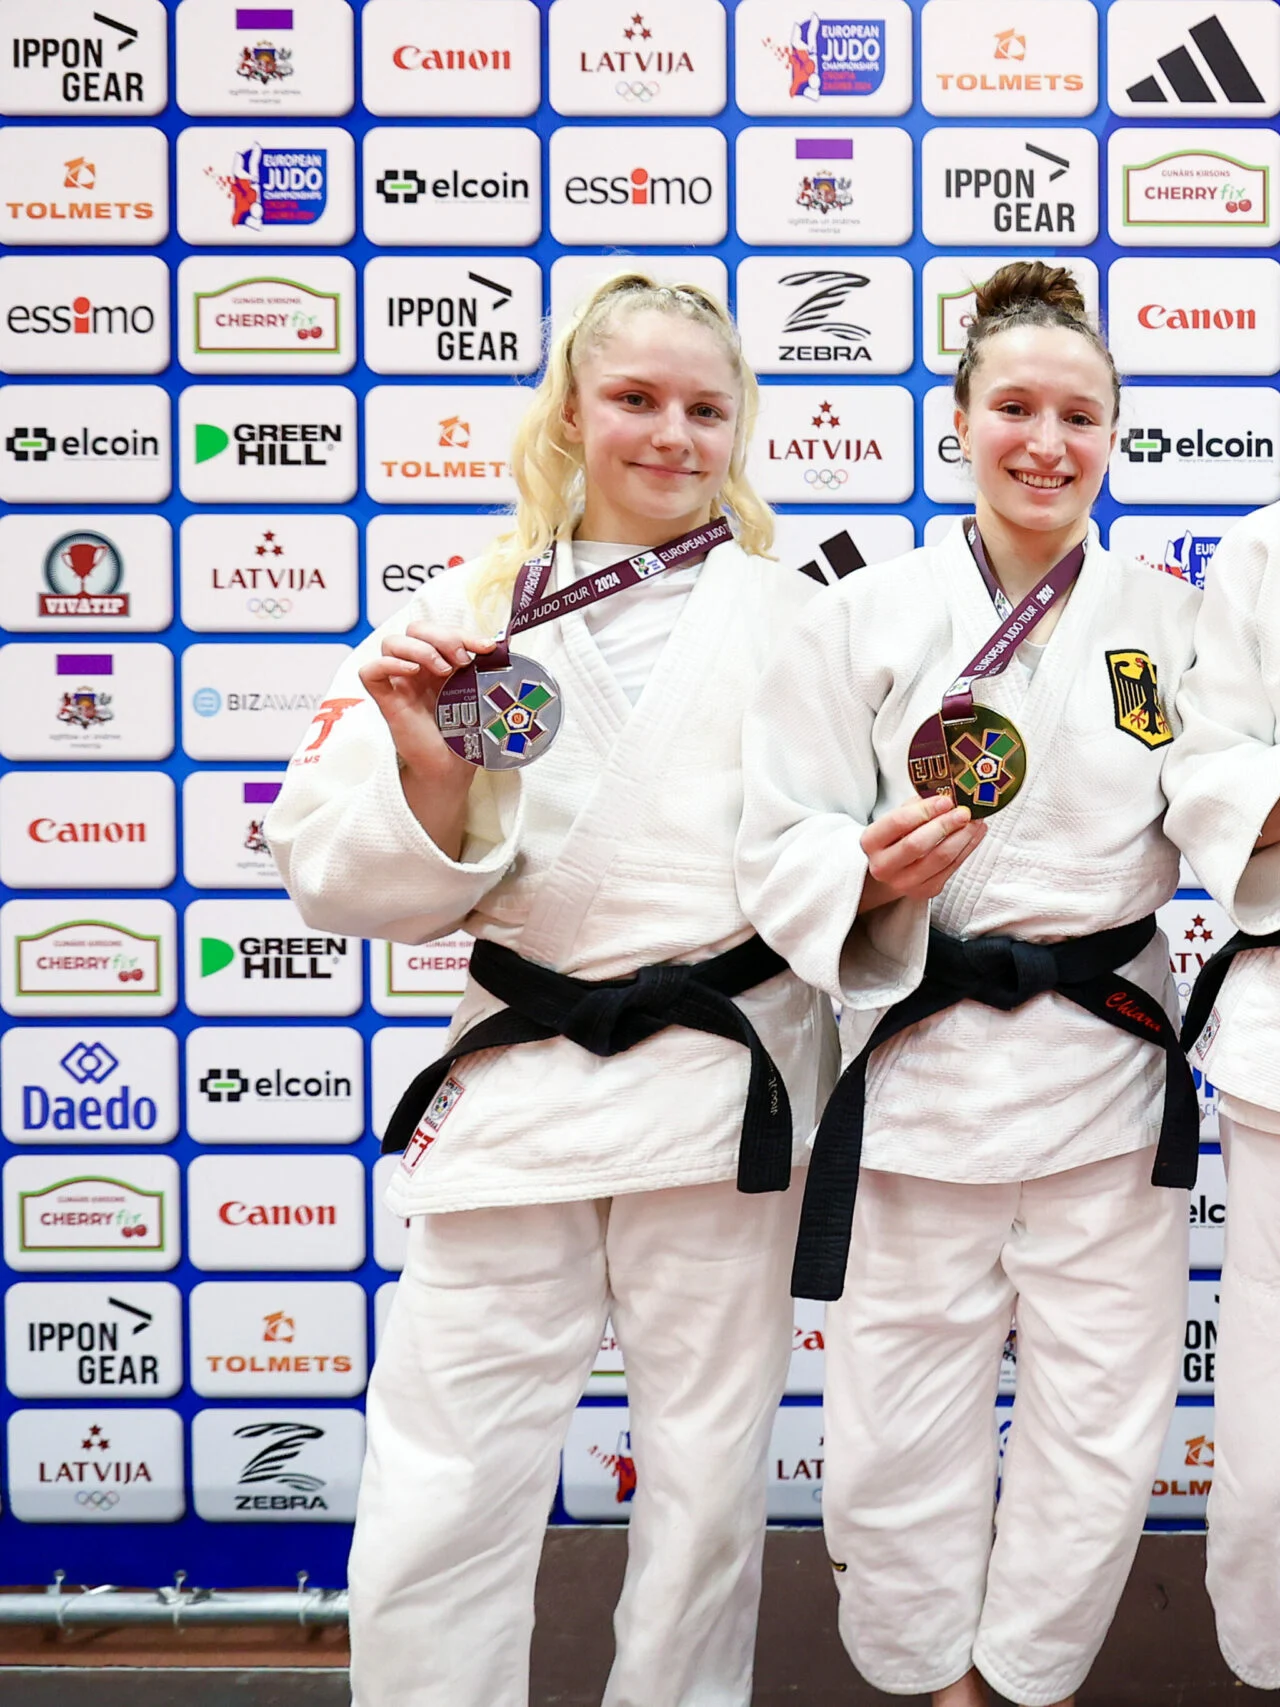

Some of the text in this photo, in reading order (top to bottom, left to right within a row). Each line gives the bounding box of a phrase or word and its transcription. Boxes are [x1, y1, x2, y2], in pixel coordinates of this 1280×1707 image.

[821, 24, 880, 39] EUROPEAN
[13, 38, 102, 68] IPPON
[393, 46, 510, 70] Canon
[821, 38, 881, 62] JUDO
[581, 52, 694, 73] LATVIJA
[63, 72, 143, 102] GEAR
[936, 74, 1084, 91] TOLMETS
[263, 153, 322, 168] EUROPEAN
[262, 167, 323, 192] JUDO
[432, 170, 528, 198] elcoin
[565, 168, 712, 204] essimo
[945, 169, 1034, 198] IPPON
[1144, 187, 1217, 200] CHERRY
[6, 202, 153, 219] TOLMETS
[994, 202, 1075, 232] GEAR
[7, 297, 154, 334] essimo
[215, 314, 288, 327] CHERRY
[389, 298, 476, 327] IPPON
[1138, 304, 1255, 329] Canon
[438, 331, 517, 361] GEAR
[779, 346, 872, 361] ZEBRA
[62, 427, 158, 456] elcoin
[234, 424, 341, 442] GREEN
[1176, 429, 1273, 457] elcoin
[238, 444, 326, 465] HILL
[769, 439, 882, 462] LATVIJA
[381, 460, 513, 478] TOLMET
[659, 533, 707, 562] EUROPEAN
[213, 569, 325, 591] LATVIJA
[45, 598, 124, 614] VIVATIP
[531, 572, 621, 620] JUDO TOUR 2024
[974, 584, 1055, 672] EUROPEAN JUDO TOUR 2024
[227, 693, 323, 712] BIZAWAY
[439, 701, 478, 728] EJU
[909, 753, 949, 783] EJU
[28, 818, 146, 843] Canon
[240, 938, 346, 955] GREEN
[36, 956, 110, 970] CHERRY
[244, 957, 332, 979] HILL
[407, 956, 471, 971] CHERR
[1105, 991, 1160, 1032] Chiara
[255, 1068, 351, 1097] elcoin
[23, 1085, 157, 1130] Daedo
[40, 1212, 114, 1226] CHERRY
[219, 1201, 336, 1226] Canon
[29, 1322, 117, 1352] IPPON
[78, 1355, 158, 1384] GEAR
[206, 1356, 352, 1373] TOLMETS
[40, 1462, 152, 1484] LATVIJA
[235, 1495, 328, 1510] ZEBRA
